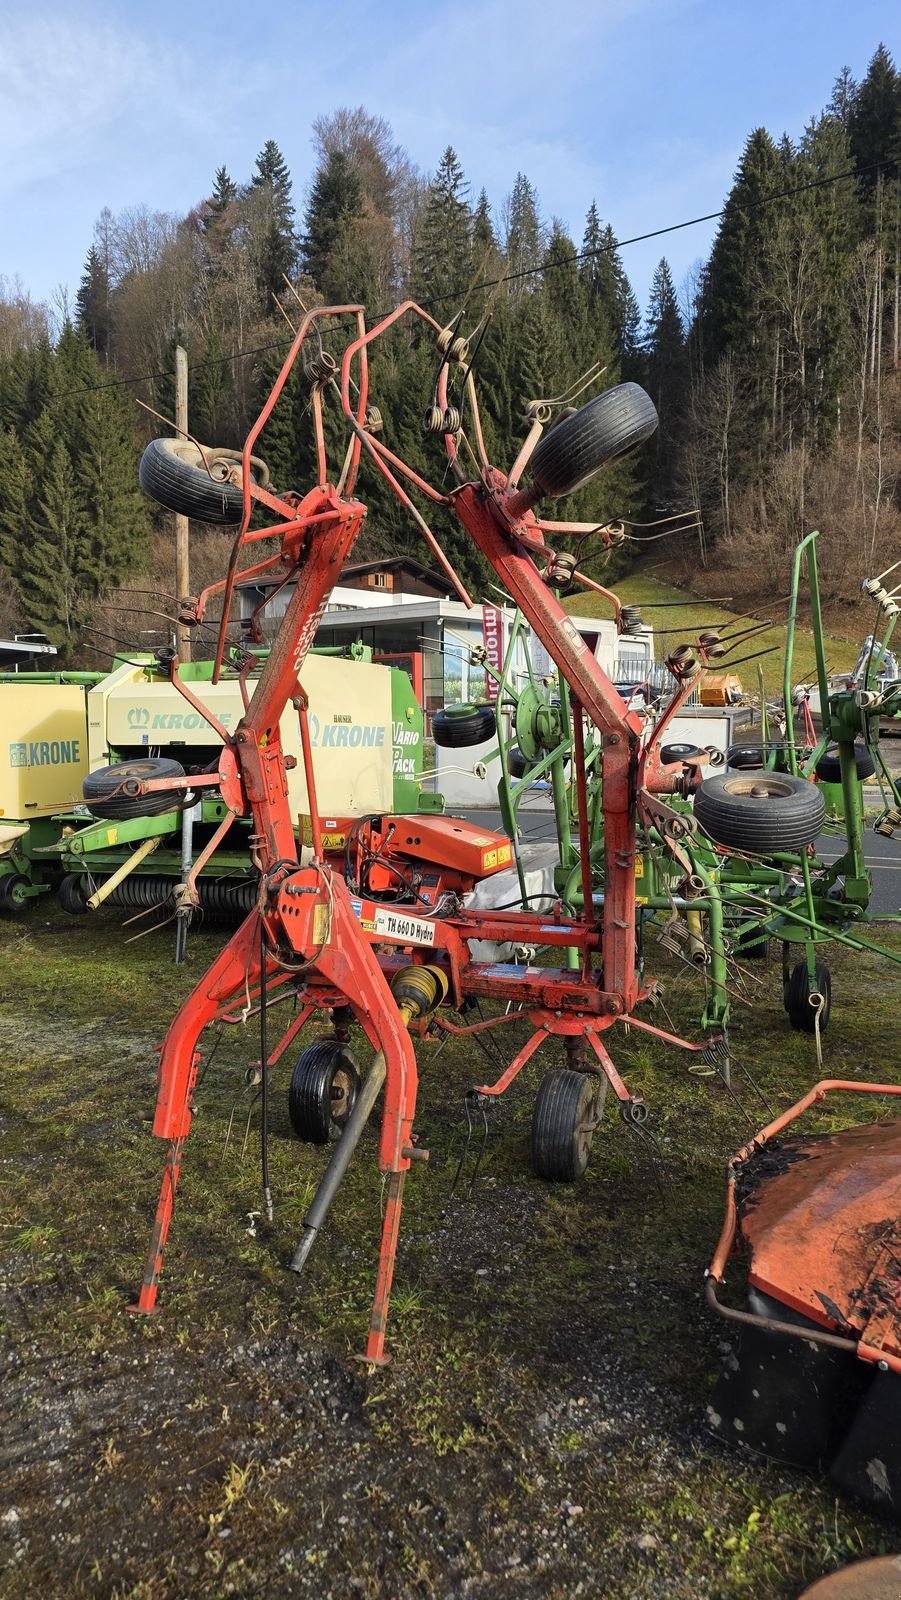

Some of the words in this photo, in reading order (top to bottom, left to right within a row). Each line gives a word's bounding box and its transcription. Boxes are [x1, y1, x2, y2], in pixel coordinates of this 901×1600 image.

[294, 612, 316, 656] Hydro
[322, 725, 385, 748] KRONE
[29, 740, 81, 767] KRONE
[388, 917, 397, 933] TH
[397, 920, 410, 936] 660
[410, 922, 415, 937] D
[416, 924, 433, 942] Hydro
